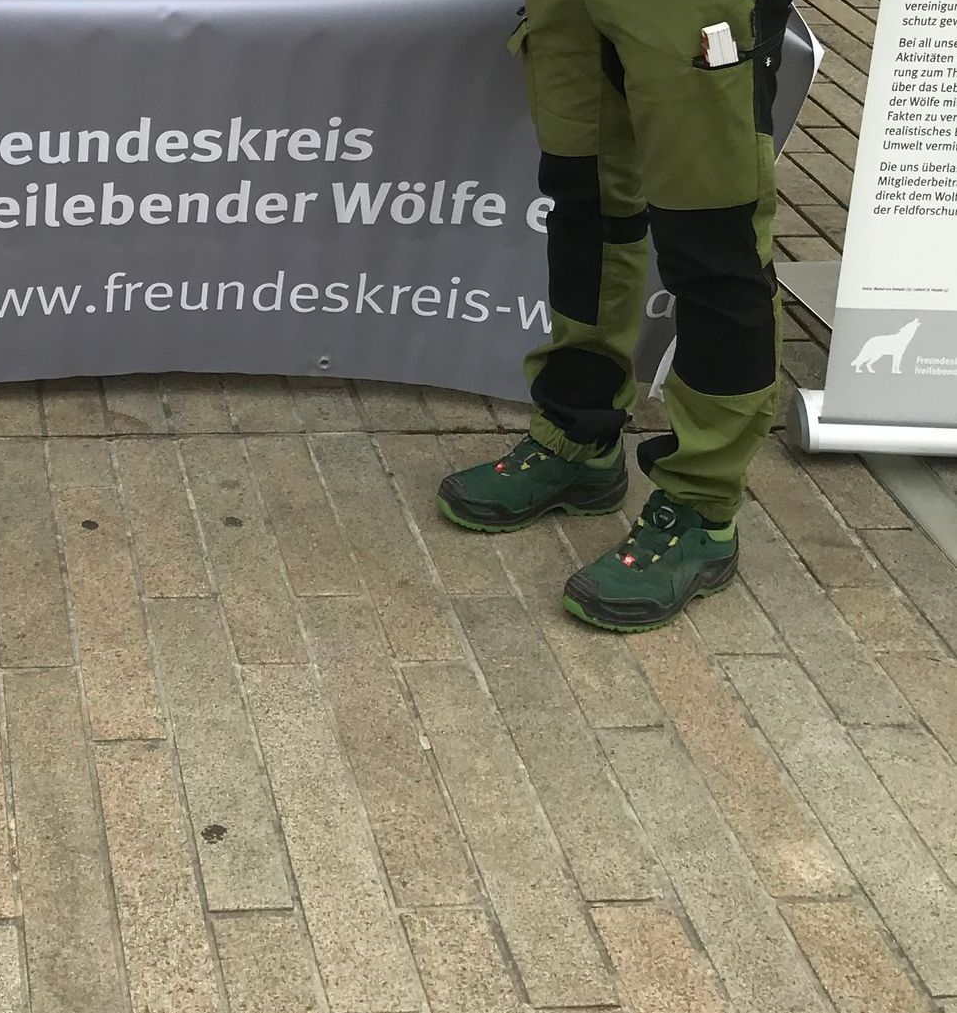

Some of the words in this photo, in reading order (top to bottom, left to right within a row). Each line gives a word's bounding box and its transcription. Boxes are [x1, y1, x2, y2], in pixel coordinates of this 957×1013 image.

[902, 16, 937, 26] schutz
[898, 37, 916, 48] Bei
[918, 37, 932, 48] all
[895, 52, 954, 63] Aktivitäten
[893, 69, 918, 79] rung
[920, 69, 944, 78] zum
[891, 82, 916, 92] über
[918, 82, 938, 92] das
[889, 96, 907, 107] der
[909, 96, 940, 107] Wölfe
[887, 111, 922, 121] Fakten
[924, 114, 937, 122] zu
[884, 126, 952, 137] realistisches
[882, 140, 923, 150] Umwelt
[879, 161, 897, 172] Die
[899, 164, 919, 172] uns
[877, 176, 957, 188] Mitgliederbeitr
[875, 190, 906, 201] direkt
[908, 191, 932, 201] dem
[332, 179, 504, 229] Wölfe
[873, 205, 891, 215] der
